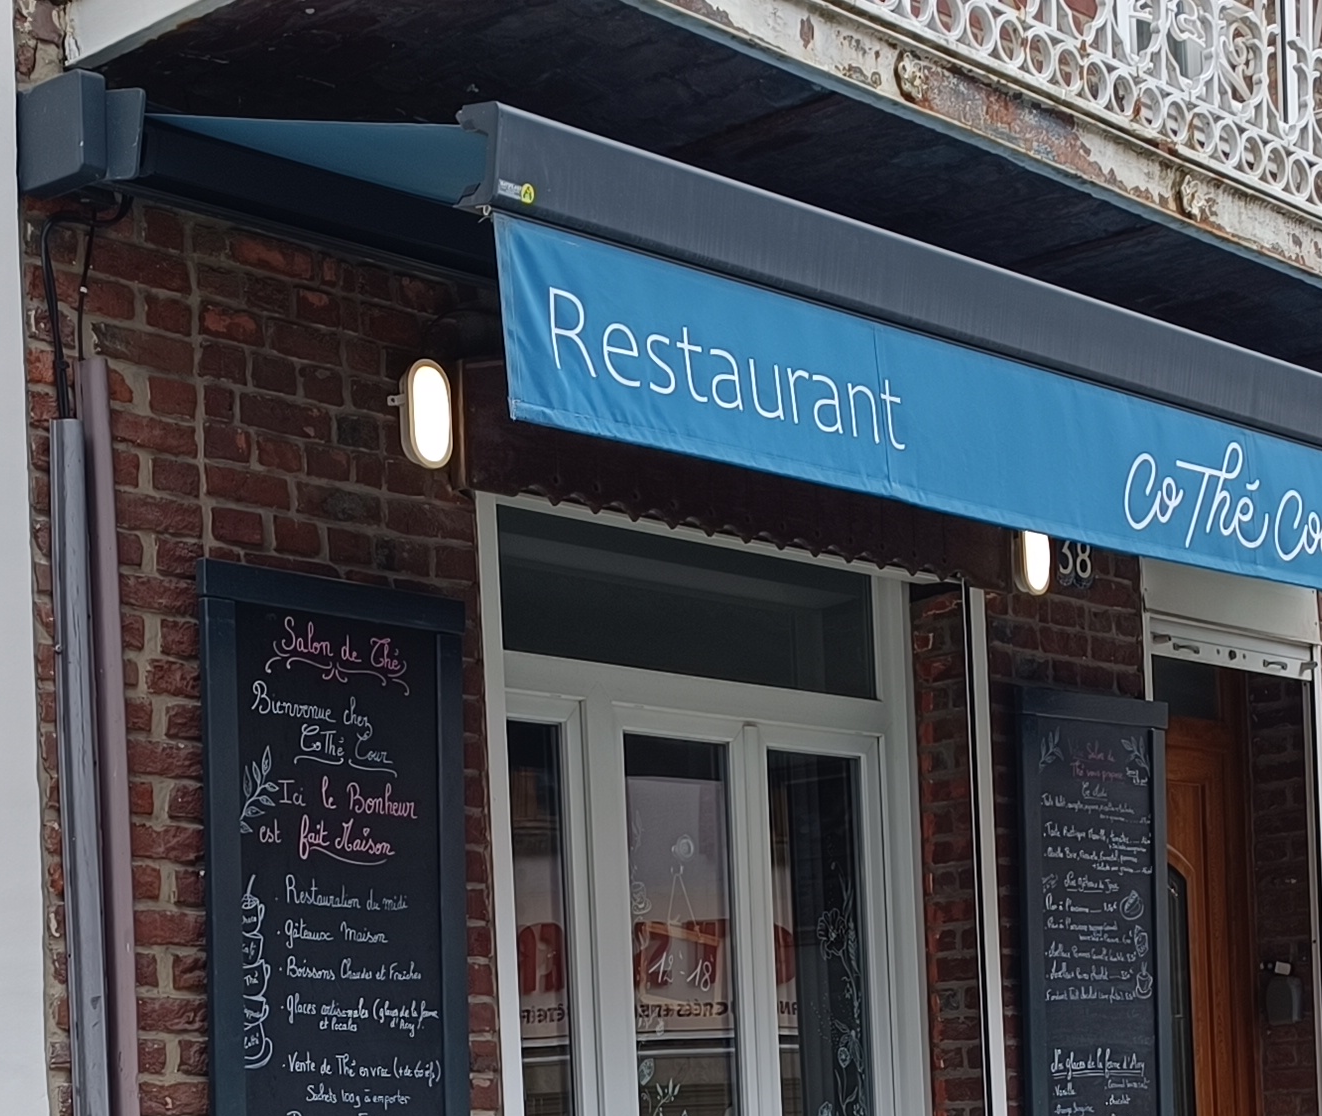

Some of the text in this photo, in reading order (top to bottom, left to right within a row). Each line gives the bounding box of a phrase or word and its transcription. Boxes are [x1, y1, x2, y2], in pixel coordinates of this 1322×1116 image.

[548, 286, 906, 450] Restaurant
[1059, 540, 1092, 579] 38
[282, 617, 402, 671] Salon de Thé
[252, 680, 373, 738] Bienvenue chez
[355, 732, 393, 764] Cour
[278, 776, 418, 820] Ici le Bonheur
[260, 814, 395, 860] est fait Maison
[286, 875, 409, 910] Restauration du midi
[287, 956, 335, 981] Boissons
[375, 964, 386, 981] et
[288, 1052, 316, 1072] Vente
[320, 1061, 332, 1075] de
[336, 1054, 356, 1077] Thé
[372, 1091, 411, 1109] emporter
